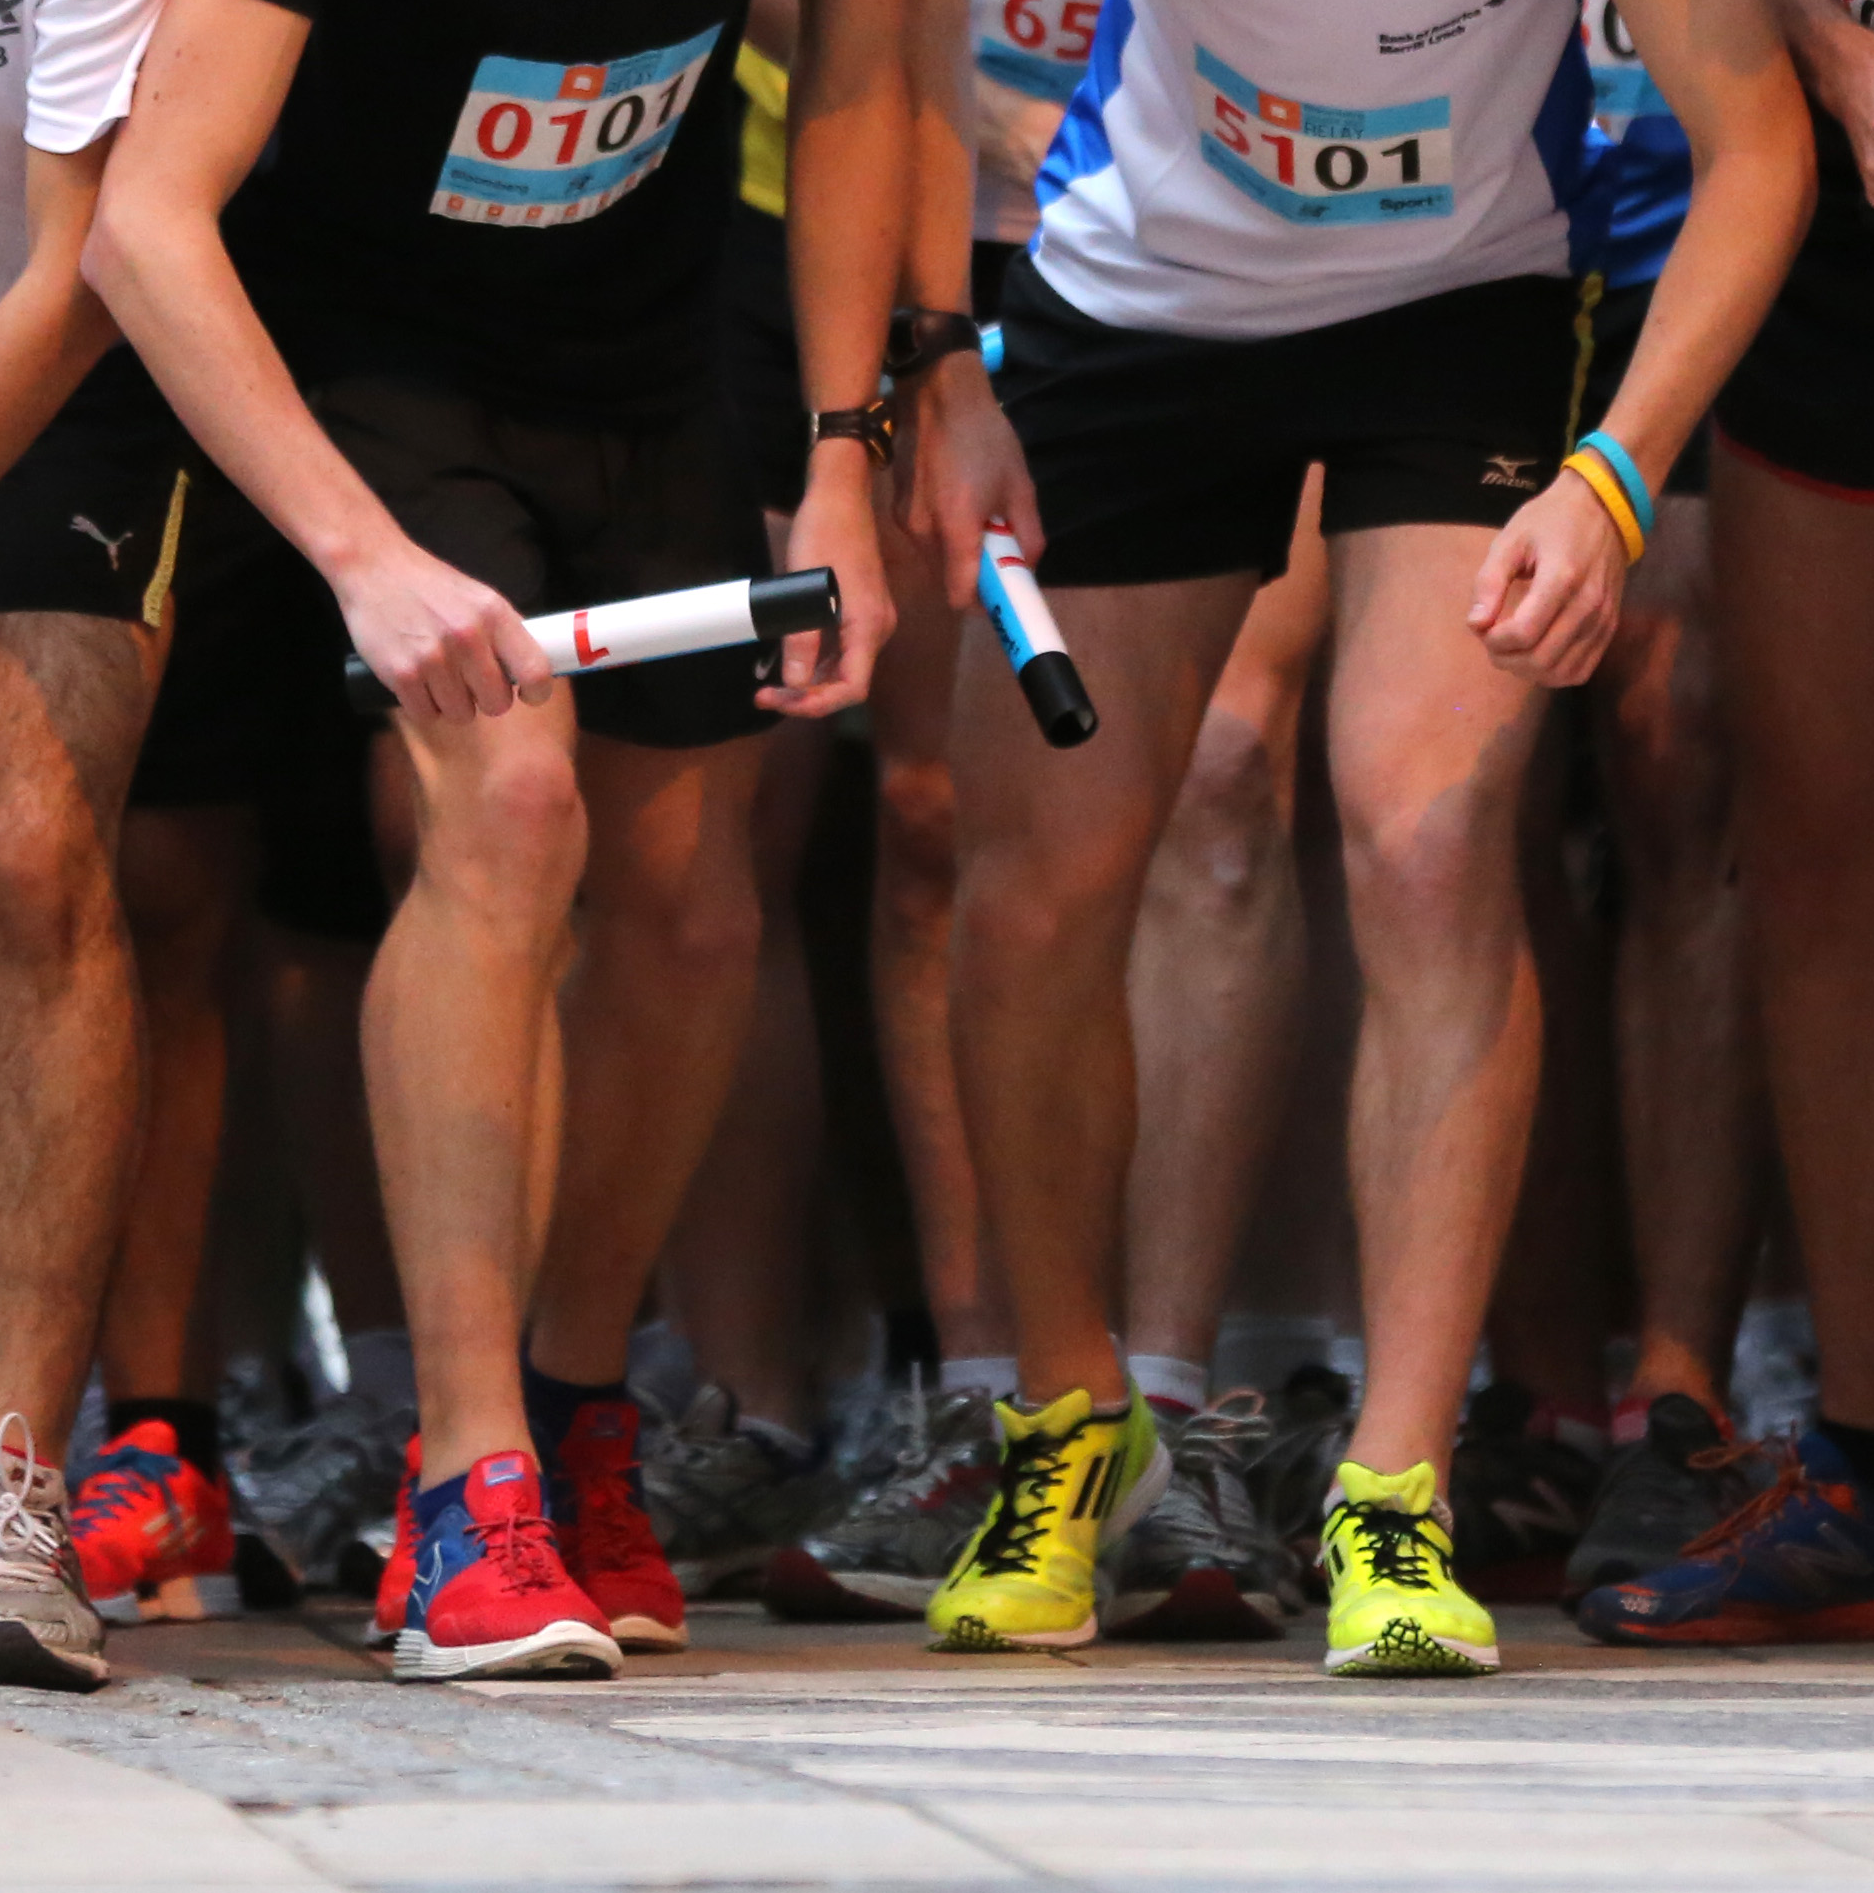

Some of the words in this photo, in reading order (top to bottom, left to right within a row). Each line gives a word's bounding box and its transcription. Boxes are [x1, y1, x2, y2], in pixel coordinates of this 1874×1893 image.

[477, 73, 686, 166] 0101
[1214, 93, 1422, 193] 5101
[1304, 120, 1367, 140] RELAY
